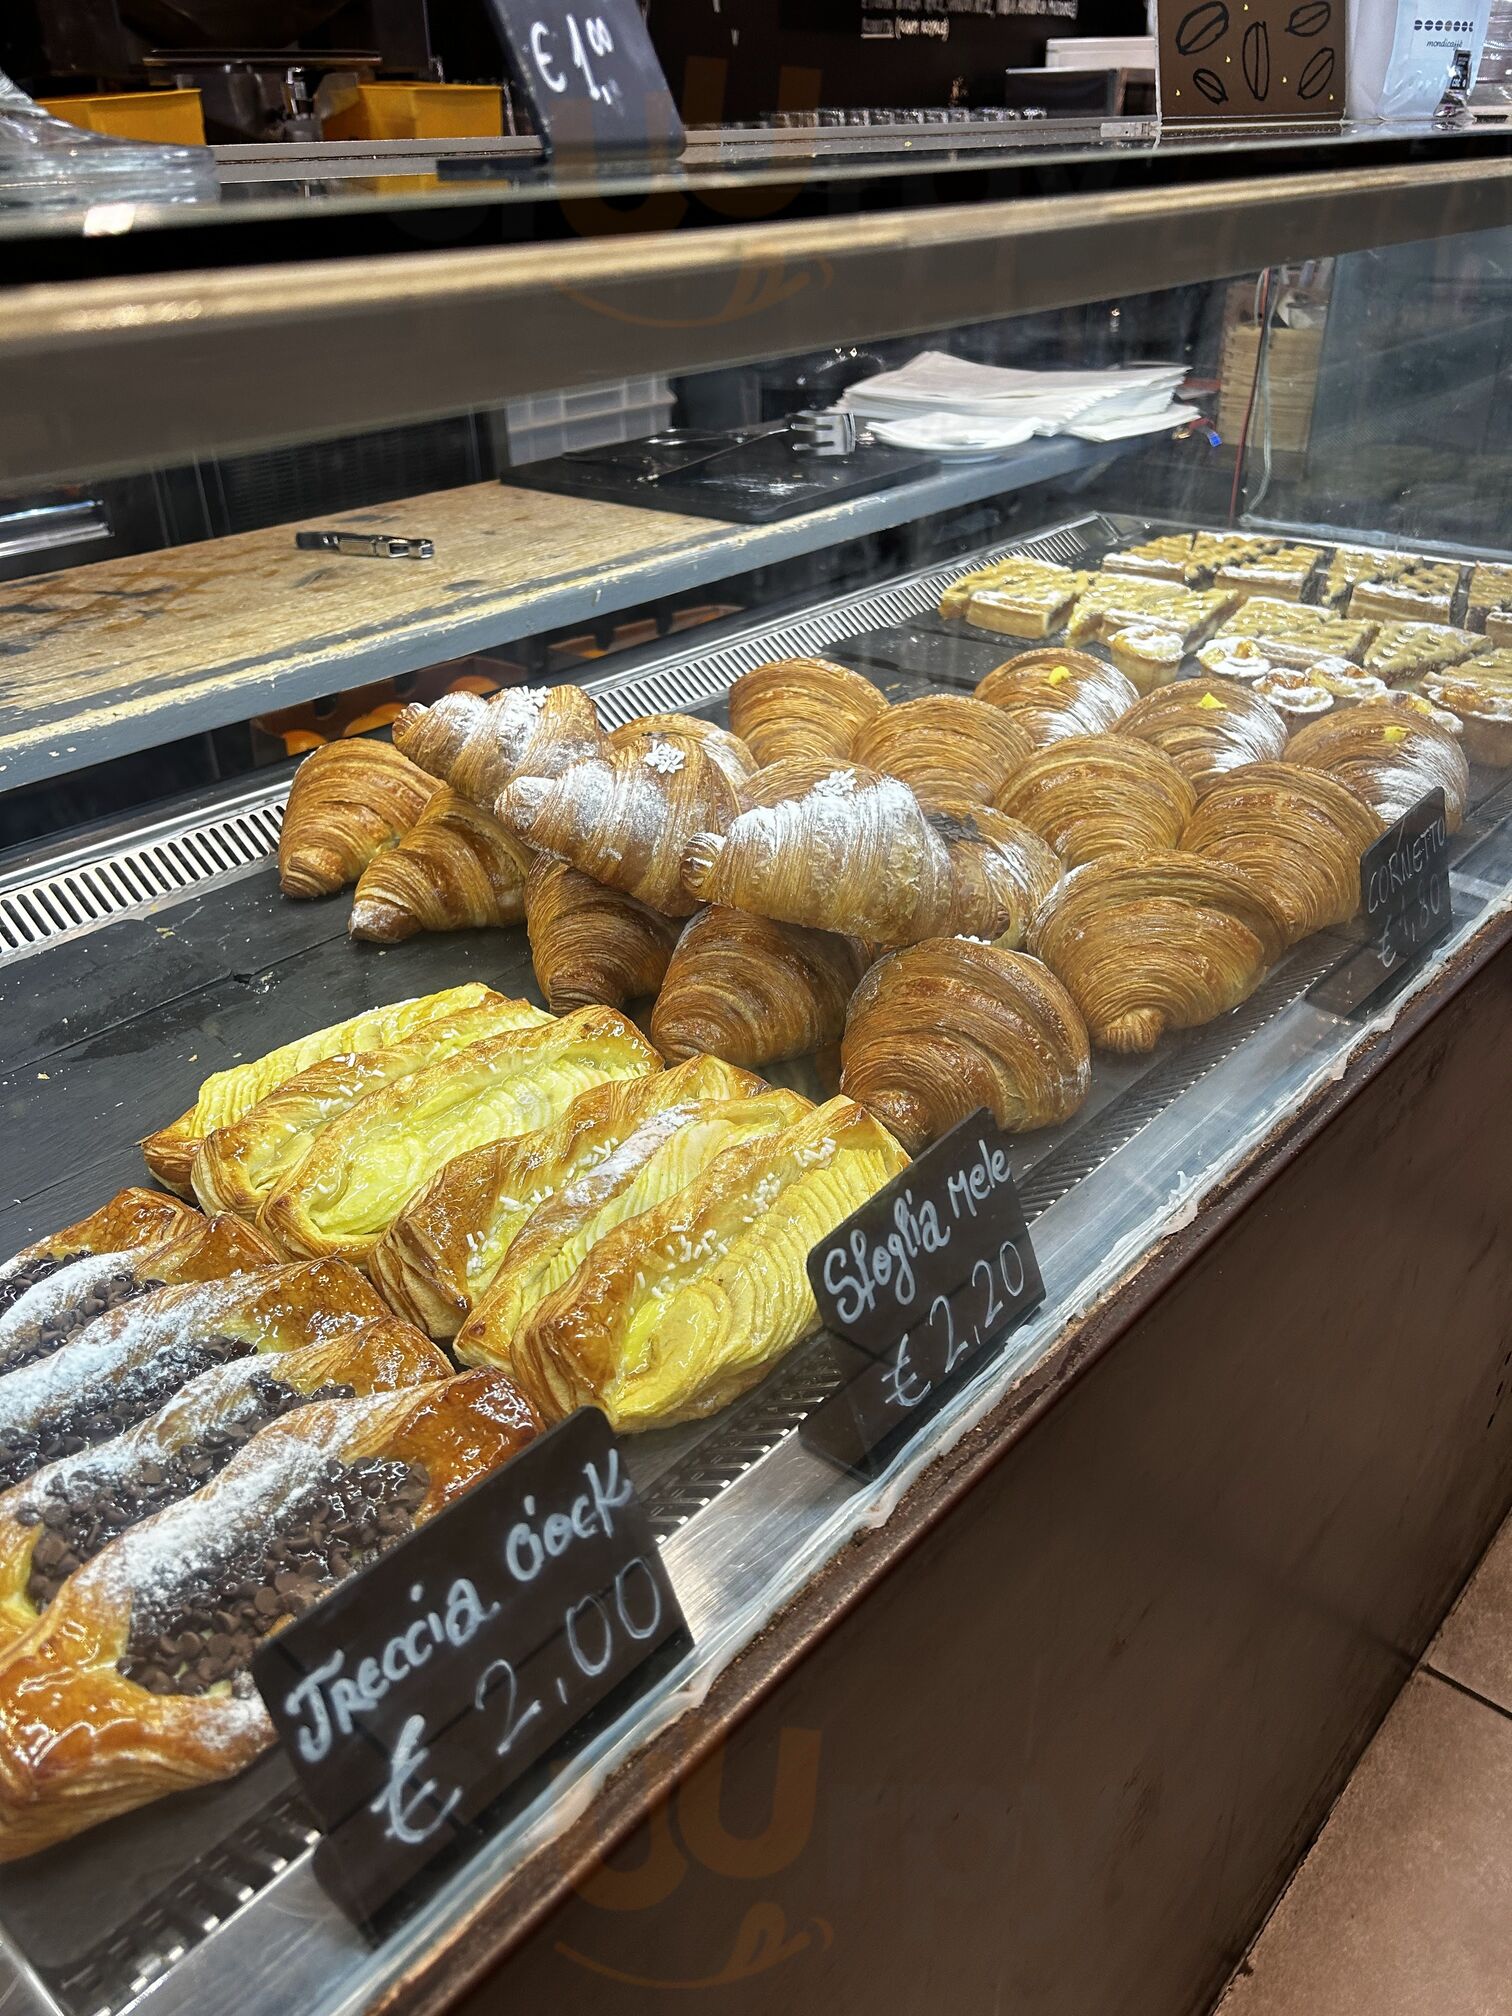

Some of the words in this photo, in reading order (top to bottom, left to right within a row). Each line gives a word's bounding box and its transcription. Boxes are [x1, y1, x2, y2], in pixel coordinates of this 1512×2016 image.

[1368, 816, 1446, 913] CORNETTO
[823, 1188, 951, 1325] Sfoglia
[946, 1139, 1011, 1218] Mele
[880, 1332, 932, 1407] €
[929, 1241, 1025, 1374] 2,20
[285, 1583, 500, 1763] Treccia
[370, 1713, 463, 1844] €
[475, 1556, 661, 1757] 2,00
